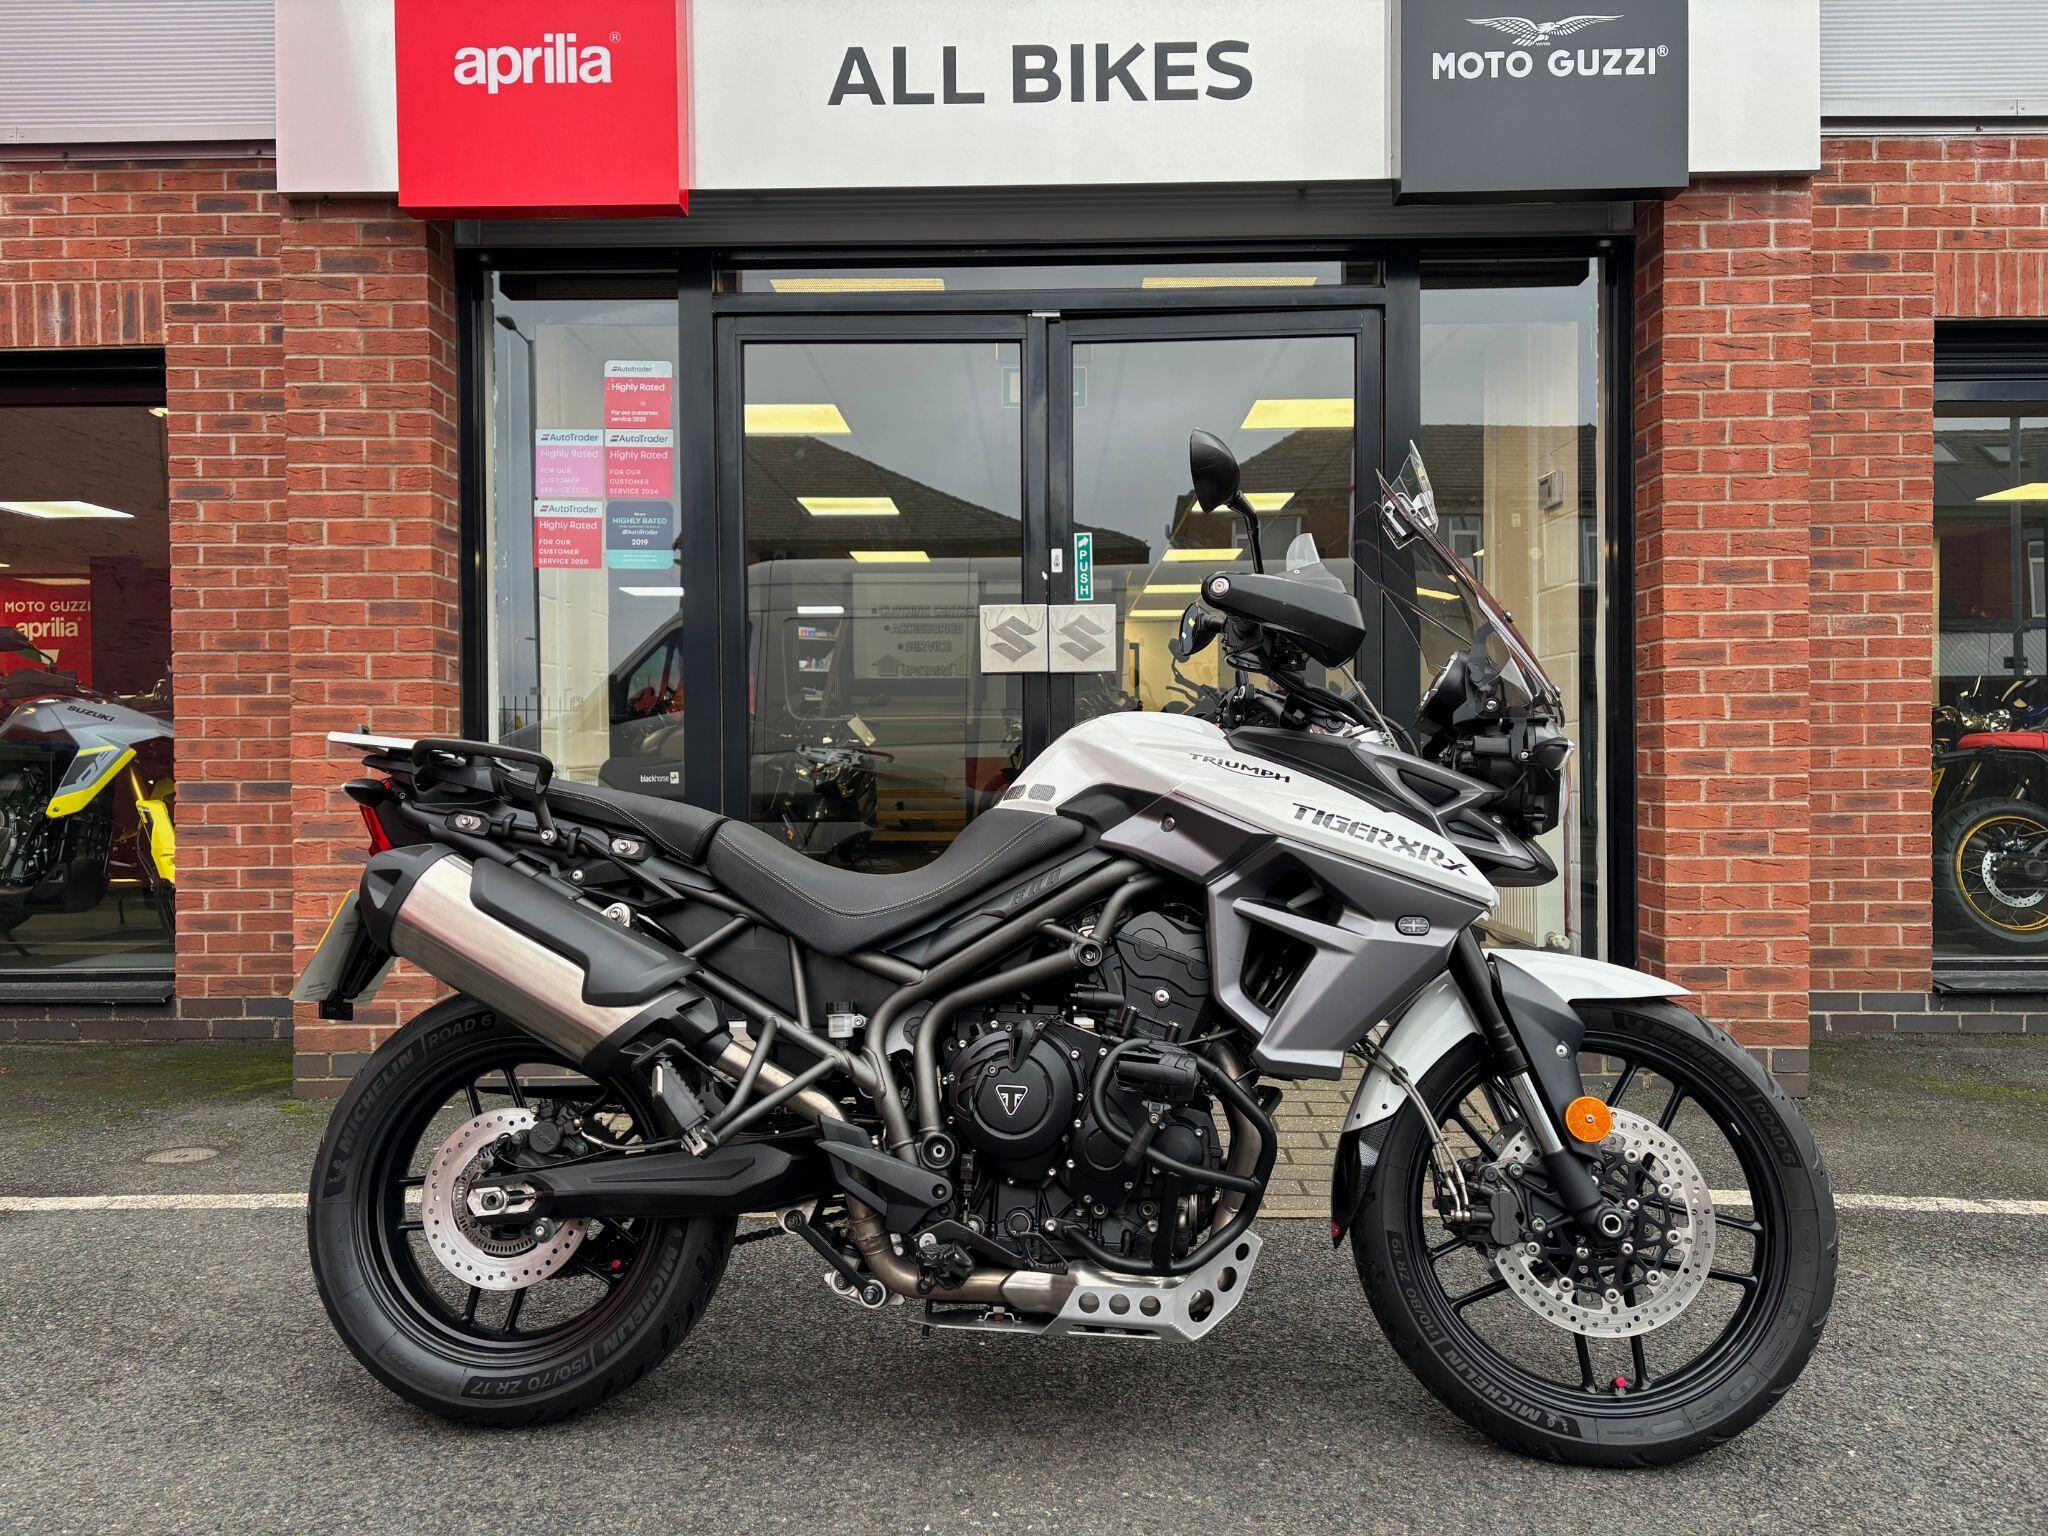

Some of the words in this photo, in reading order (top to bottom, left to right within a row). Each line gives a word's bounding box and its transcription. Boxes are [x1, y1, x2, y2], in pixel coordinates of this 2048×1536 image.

[827, 46, 985, 106] ALL
[1012, 39, 1253, 104] BIKES
[1432, 50, 1533, 80] MOTO
[611, 383, 638, 392] Highly
[640, 383, 665, 391] Rated
[549, 433, 599, 442] AutoTrader
[618, 434, 668, 443] AutoTrader
[540, 450, 570, 459] Highly
[571, 450, 598, 458] Rated
[609, 451, 639, 460] Highly
[640, 451, 668, 459] Rated
[549, 505, 598, 513] AutoTrader
[538, 521, 570, 531] Highly
[570, 521, 597, 530] Rated
[612, 516, 641, 524] HIGHLY
[631, 538, 649, 546] 2019
[1079, 549, 1089, 596] PUSH
[4, 601, 46, 613] MOTO
[49, 600, 91, 612] GUZZI
[15, 617, 79, 642] aprilia
[67, 705, 115, 722] SUZUKI
[1190, 753, 1291, 783] TRIUMPH
[428, 1018, 476, 1049] ROAD
[481, 1014, 493, 1027] 6
[1648, 1026, 1747, 1092] MICHELIN
[338, 1048, 416, 1155] MICHELIN
[1752, 1103, 1788, 1149] ROAD
[1391, 1237, 1401, 1257] 19
[1396, 1261, 1410, 1283] ZR
[601, 1247, 677, 1357] MICHELIN
[1405, 1288, 1438, 1339] 110/80
[527, 1354, 592, 1391] 150/70
[469, 1381, 491, 1395] 17
[494, 1379, 522, 1395] ZR
[1444, 1351, 1542, 1423] MICHELIN
